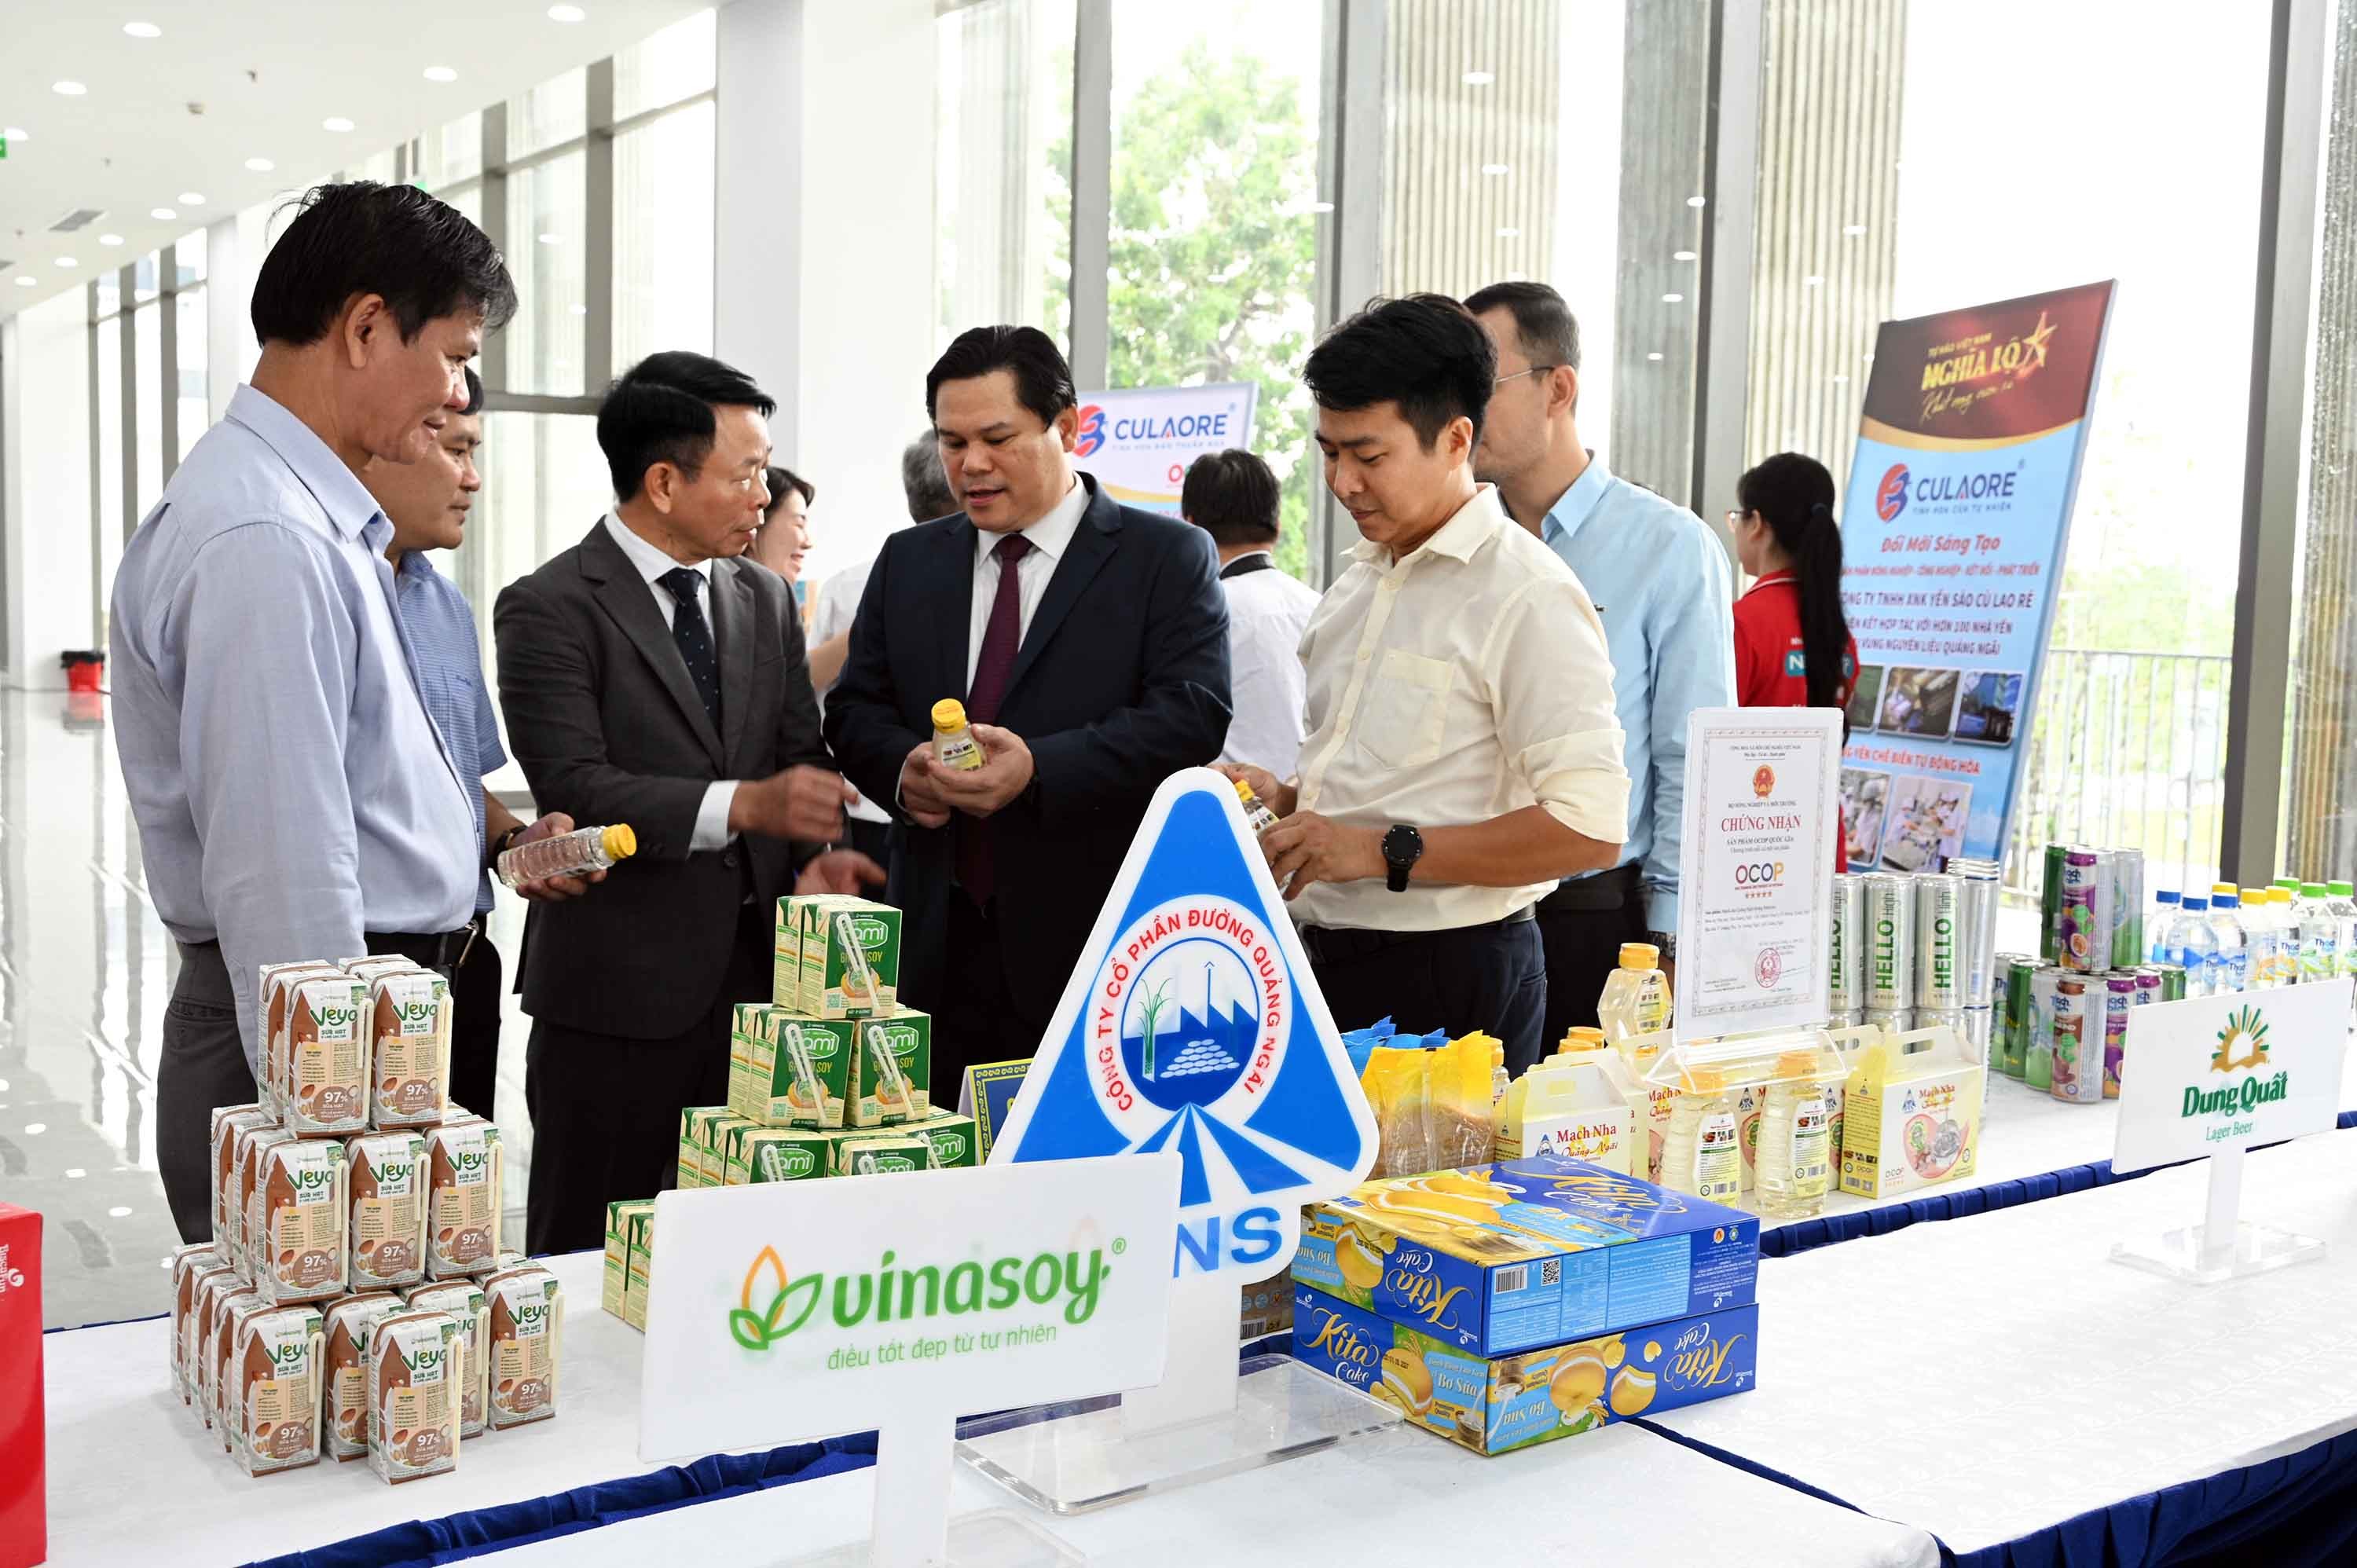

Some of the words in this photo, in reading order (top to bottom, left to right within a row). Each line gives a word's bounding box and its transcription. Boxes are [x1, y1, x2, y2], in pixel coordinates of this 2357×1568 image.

[1115, 414, 1227, 440] CULAORE
[1916, 471, 2017, 501] CULAORE
[1722, 813, 1764, 832] CHỨNG
[1768, 812, 1802, 833] NHẬN
[1736, 862, 1784, 885] OCOP
[854, 925, 884, 941] ami
[1127, 914, 1181, 962] PHẦN
[1188, 908, 1254, 948] ĐƯỜNG
[867, 951, 883, 962] SOY
[1875, 920, 1894, 989] HELLO
[1934, 918, 1952, 988] HELLO
[1106, 957, 1129, 998] CỔ
[1253, 946, 1283, 1028] QUẢNG
[310, 1006, 357, 1026] Veyo
[1098, 1007, 1114, 1039] TY
[804, 1035, 835, 1051] ami
[885, 1031, 915, 1047] ami
[816, 1061, 833, 1073] SOY
[900, 1057, 915, 1068] SOY
[1244, 1037, 1276, 1094] NGÃI
[1098, 1046, 1133, 1112] CÔNG
[2181, 1086, 2238, 1118] Dung
[2239, 1070, 2288, 1113] Quất
[1593, 1123, 1616, 1138] Nha
[2206, 1126, 2231, 1143] Lager
[2233, 1121, 2253, 1136] Beer
[930, 1138, 962, 1156] ami
[780, 1155, 811, 1171] ami
[1173, 1207, 1282, 1279] NS
[1396, 1249, 1433, 1273] Cake
[833, 1249, 1110, 1328] vinasoy
[1386, 1269, 1475, 1330] Kita
[827, 1343, 871, 1370] điều
[878, 1339, 905, 1364] tốt
[911, 1337, 947, 1361] đẹp
[954, 1331, 975, 1353] từ
[980, 1332, 1000, 1352] tự
[1006, 1324, 1057, 1346] nhiên
[1300, 1306, 1380, 1367] Kita
[1674, 1322, 1710, 1351] Cake
[1335, 1361, 1371, 1384] Cake
[1664, 1334, 1747, 1390] Kita
